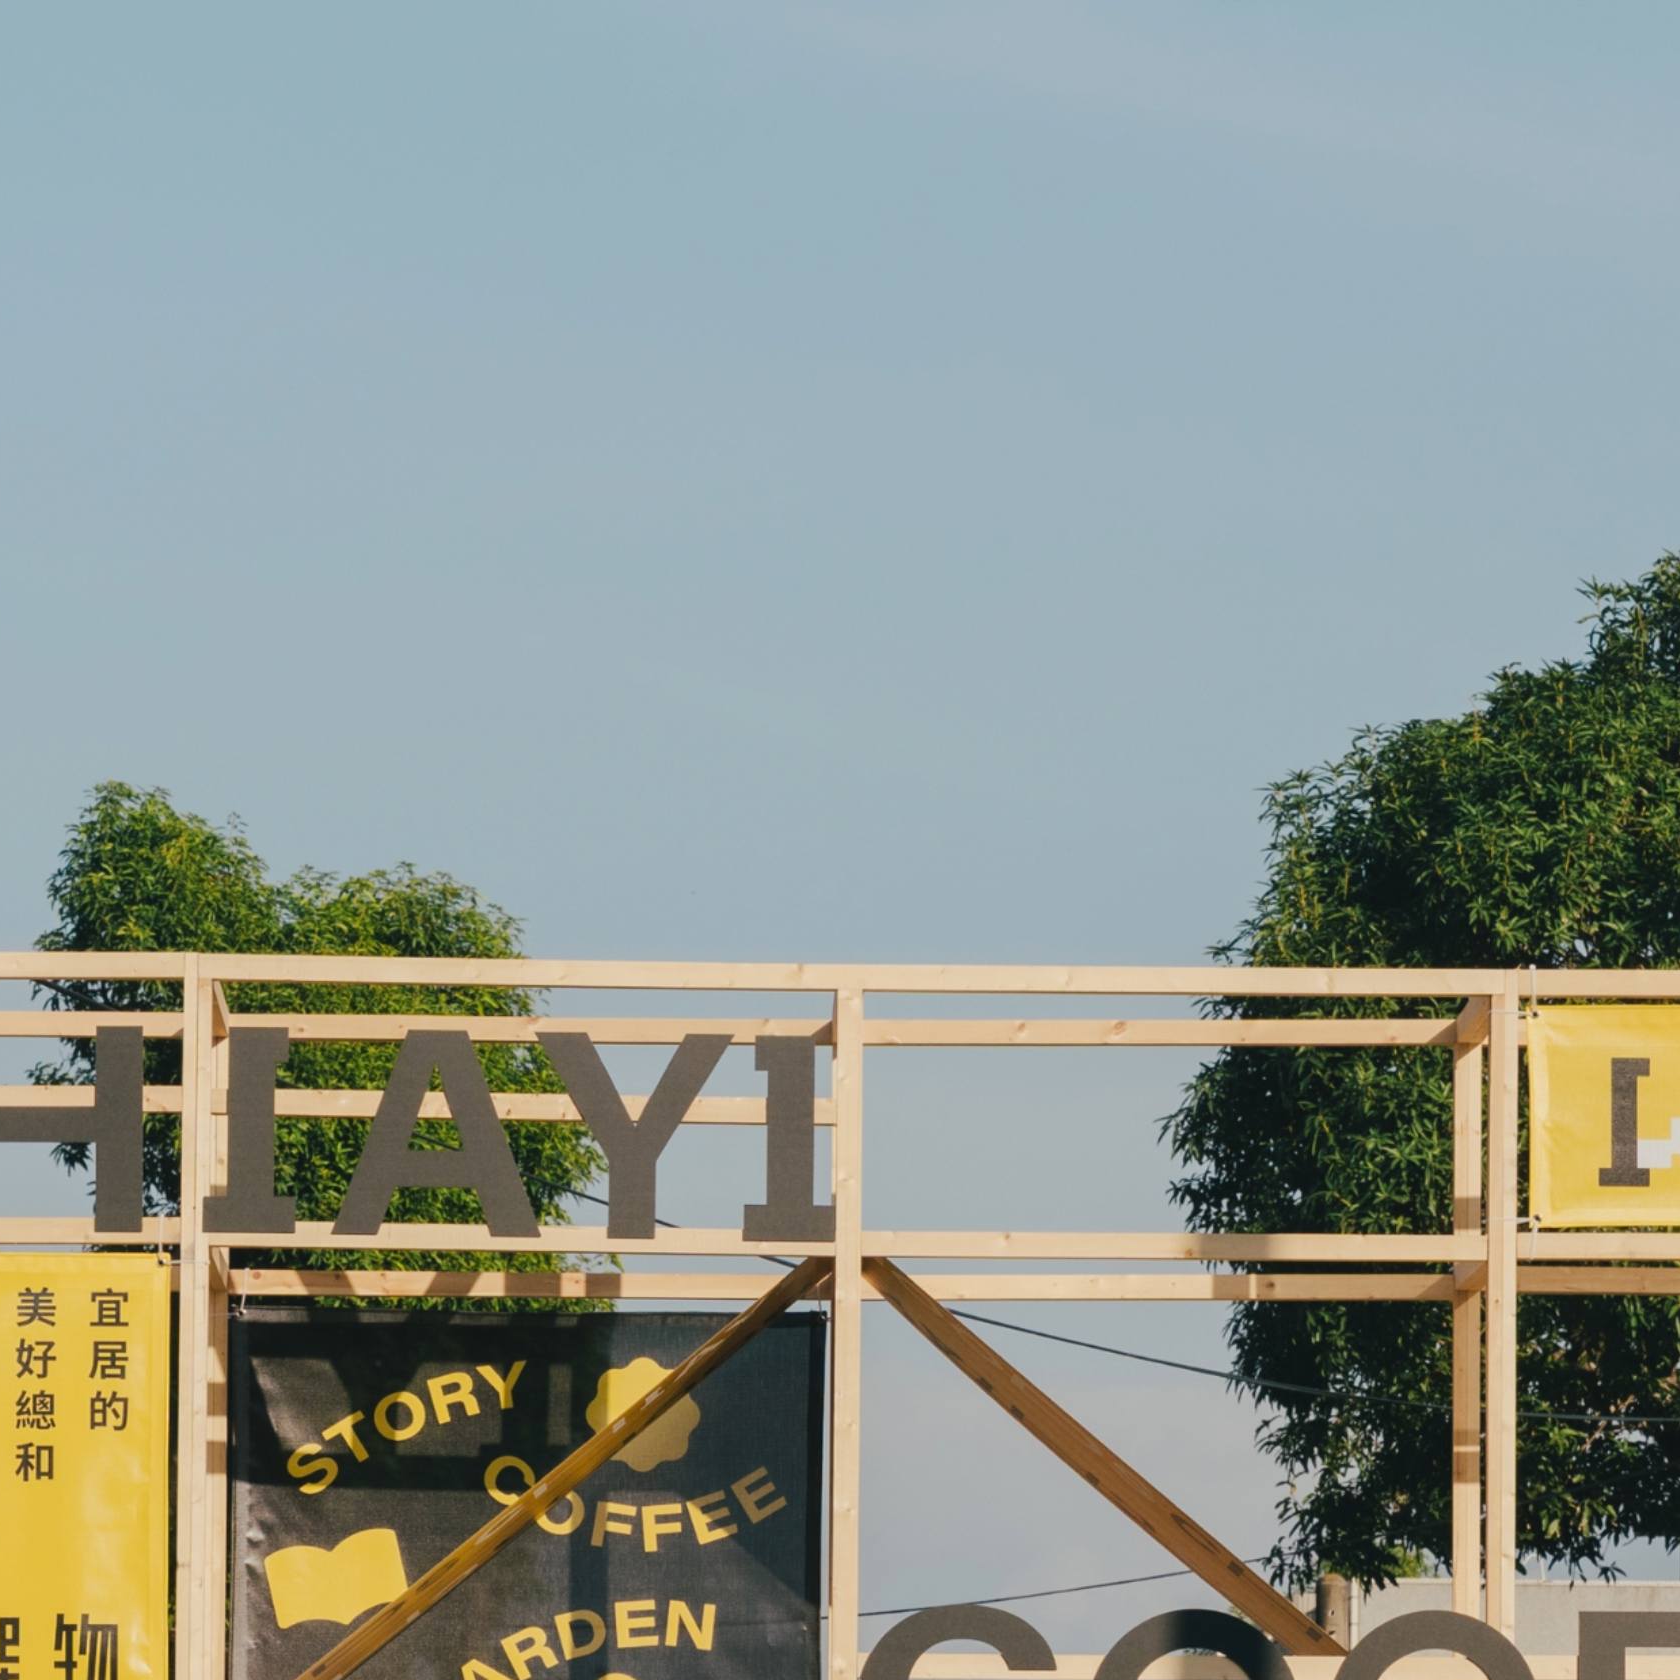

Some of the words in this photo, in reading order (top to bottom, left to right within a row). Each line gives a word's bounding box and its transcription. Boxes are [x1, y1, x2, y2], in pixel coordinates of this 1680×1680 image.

[14, 1286, 57, 1483] 美好總和
[88, 1287, 129, 1432] 宜居的
[286, 1360, 527, 1495] STORY
[484, 1455, 787, 1553] COFFEE
